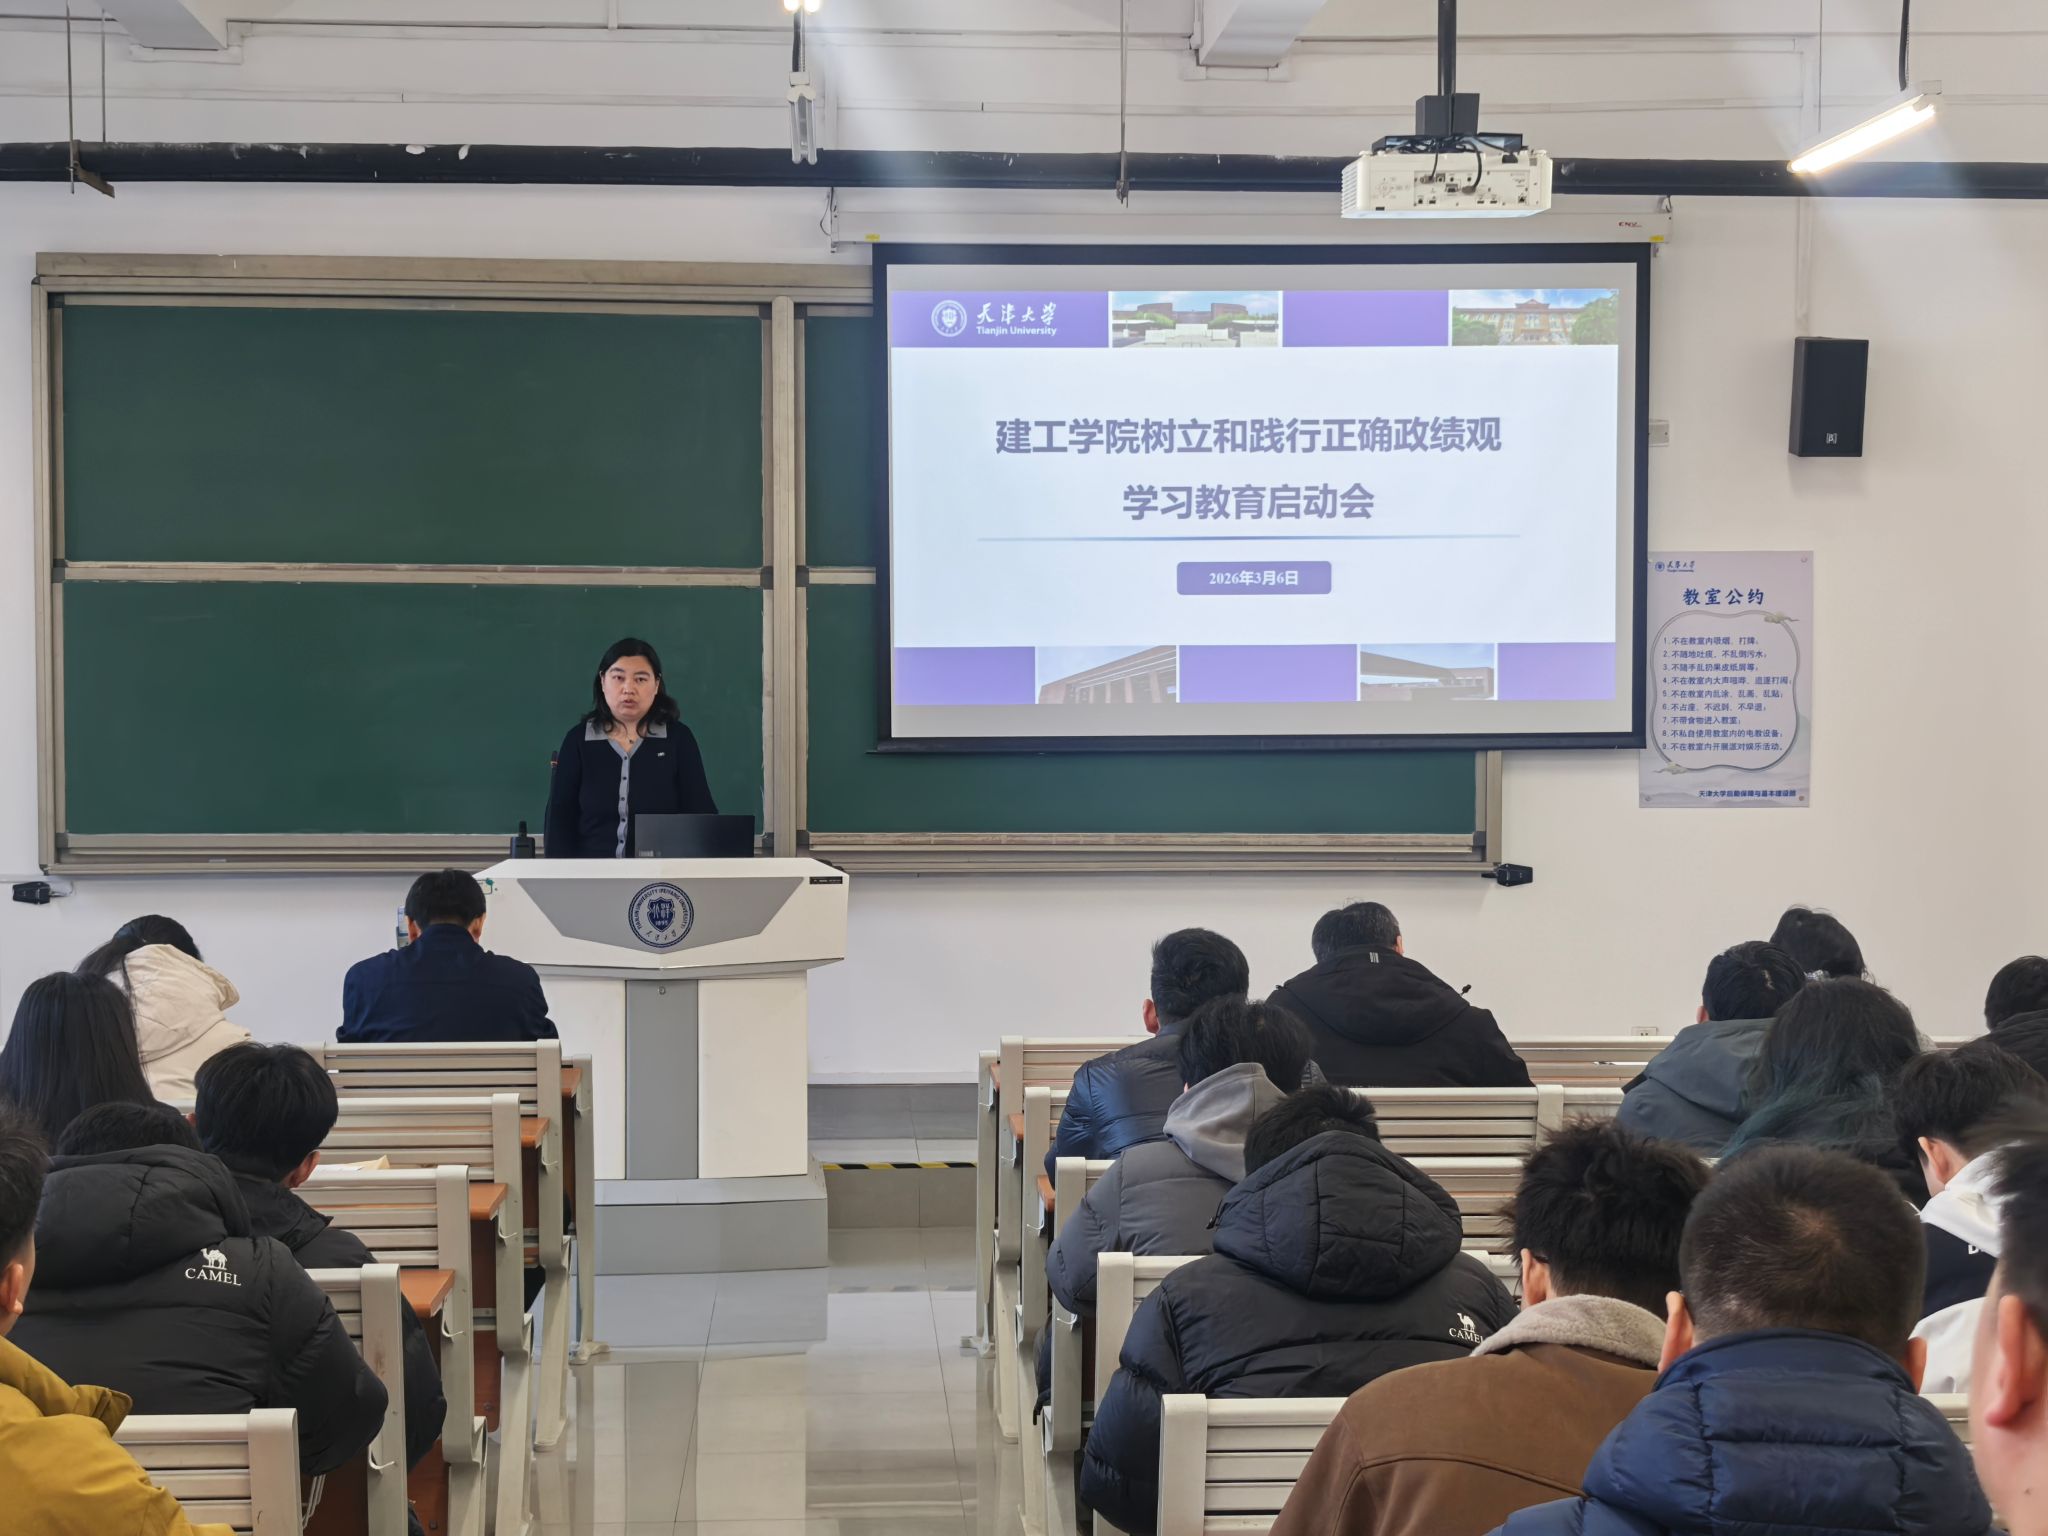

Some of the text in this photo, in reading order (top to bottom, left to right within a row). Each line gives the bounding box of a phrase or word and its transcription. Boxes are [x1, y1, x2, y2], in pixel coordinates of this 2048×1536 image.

[976, 301, 1057, 325] 天津大学
[976, 326, 1057, 337] Tianjin University
[995, 416, 1502, 454] 建工学院树立和践行正确政绩观
[1122, 483, 1375, 521] 学习教育启动会
[1209, 570, 1299, 586] 2026年3月6日
[1682, 587, 1764, 606] 教室公约
[185, 1268, 241, 1286] CAMEL
